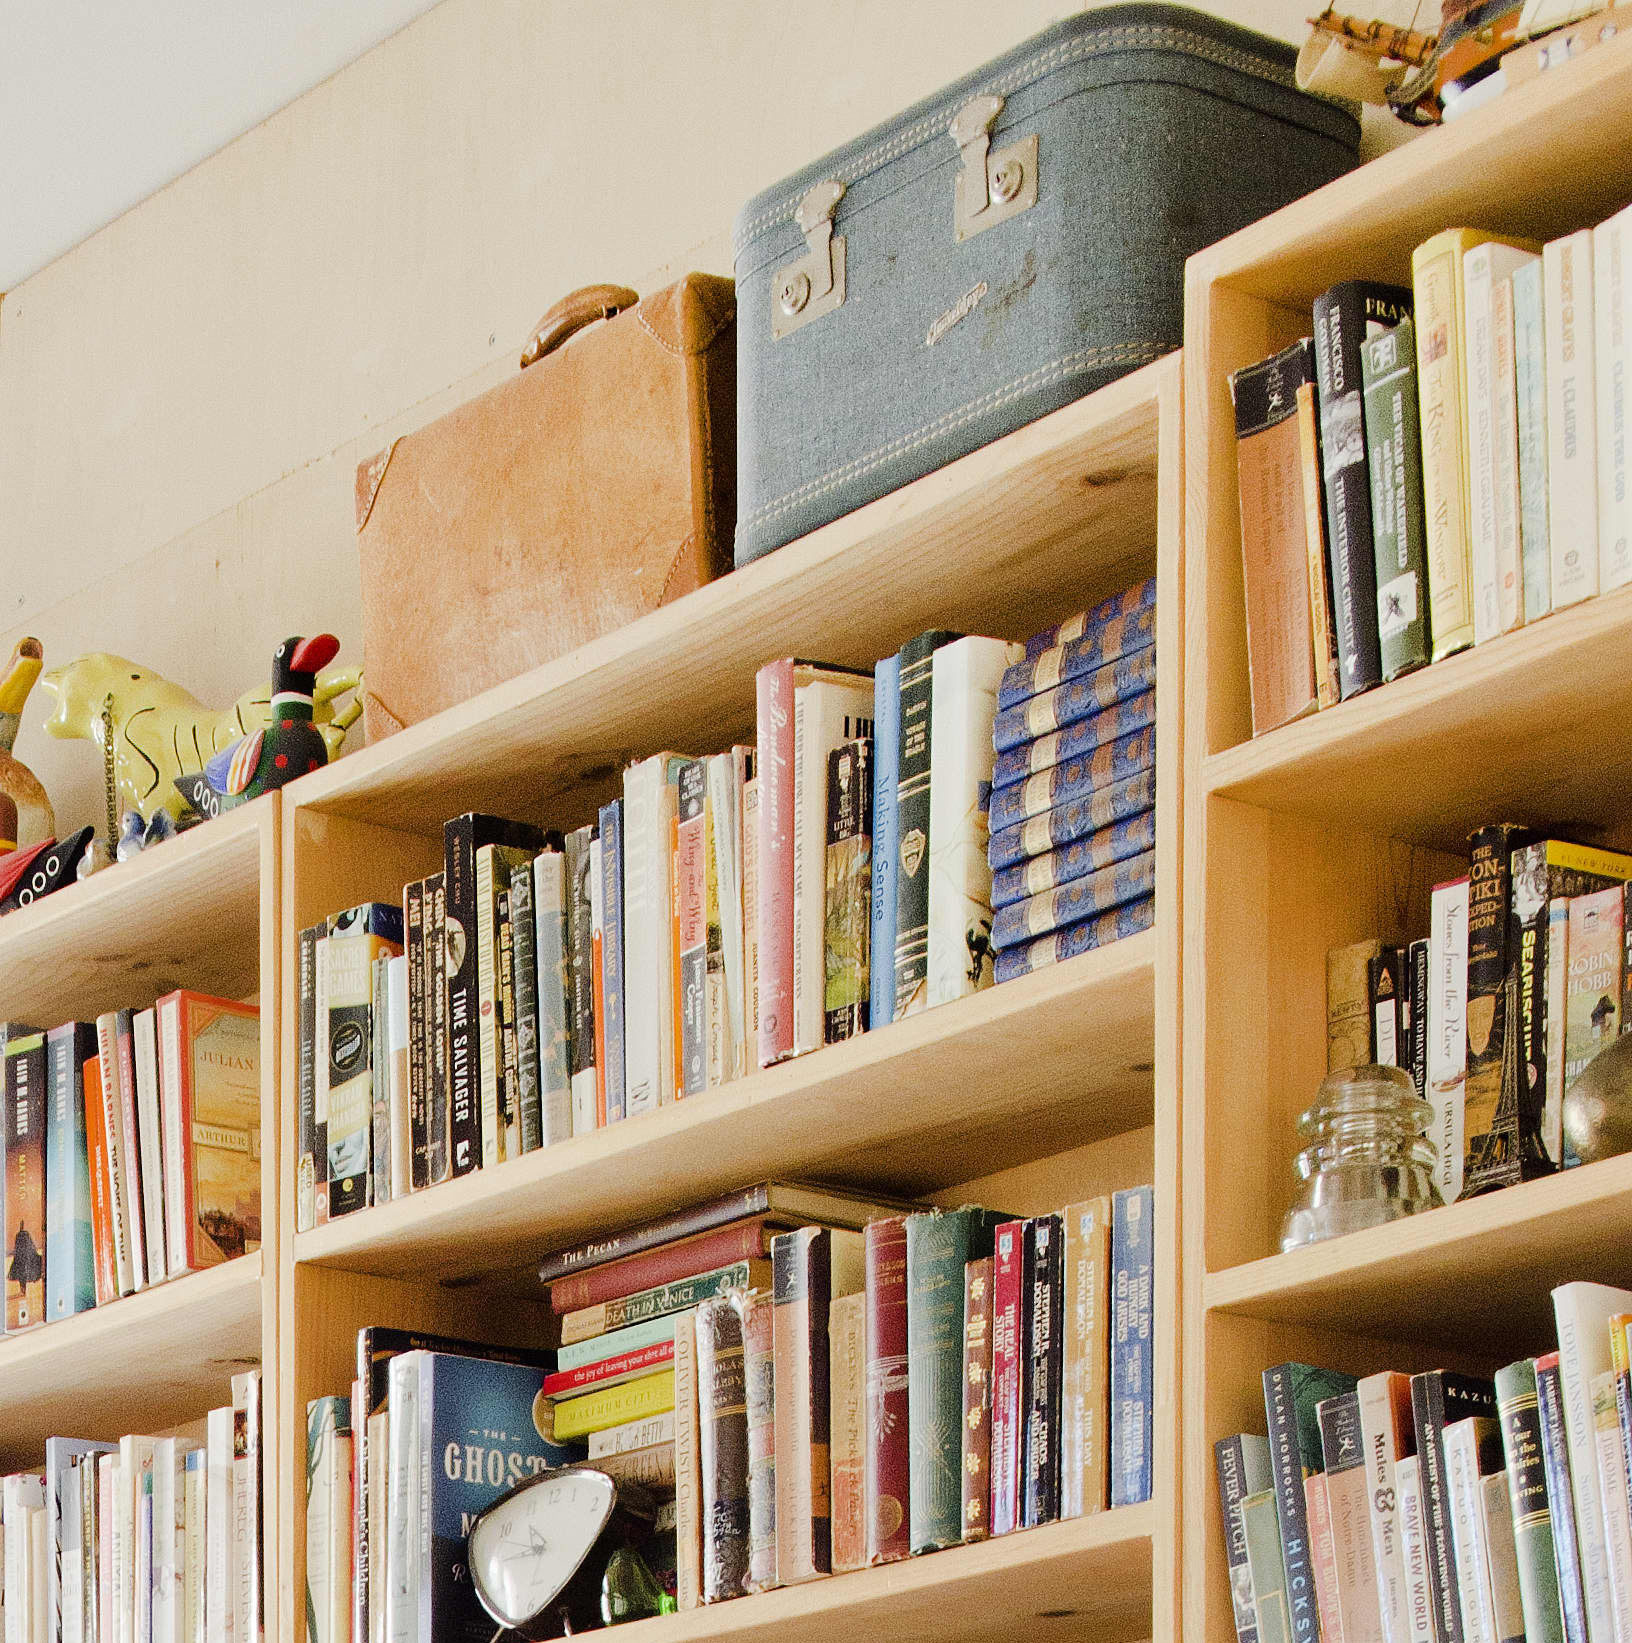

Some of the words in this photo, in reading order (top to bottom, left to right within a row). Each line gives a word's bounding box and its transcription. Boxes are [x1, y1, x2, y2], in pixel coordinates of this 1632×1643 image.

[452, 988, 467, 1031] TIME
[199, 1049, 255, 1072] JULIAN
[453, 1037, 469, 1123] SALVAGER
[196, 1129, 245, 1144] ARTHUR
[677, 1339, 689, 1411] OLIVER
[1272, 1373, 1286, 1425] DYLAN
[677, 1415, 689, 1480] TWIST
[549, 1487, 561, 1504] 12
[1278, 1433, 1297, 1517] HORROCKS
[1372, 1432, 1386, 1484] Mules
[1381, 1519, 1393, 1556] Men
[499, 1524, 513, 1538] 10
[1405, 1495, 1421, 1544] BRAVE
[1410, 1546, 1423, 1576] NEW
[1413, 1580, 1428, 1631] WORLD
